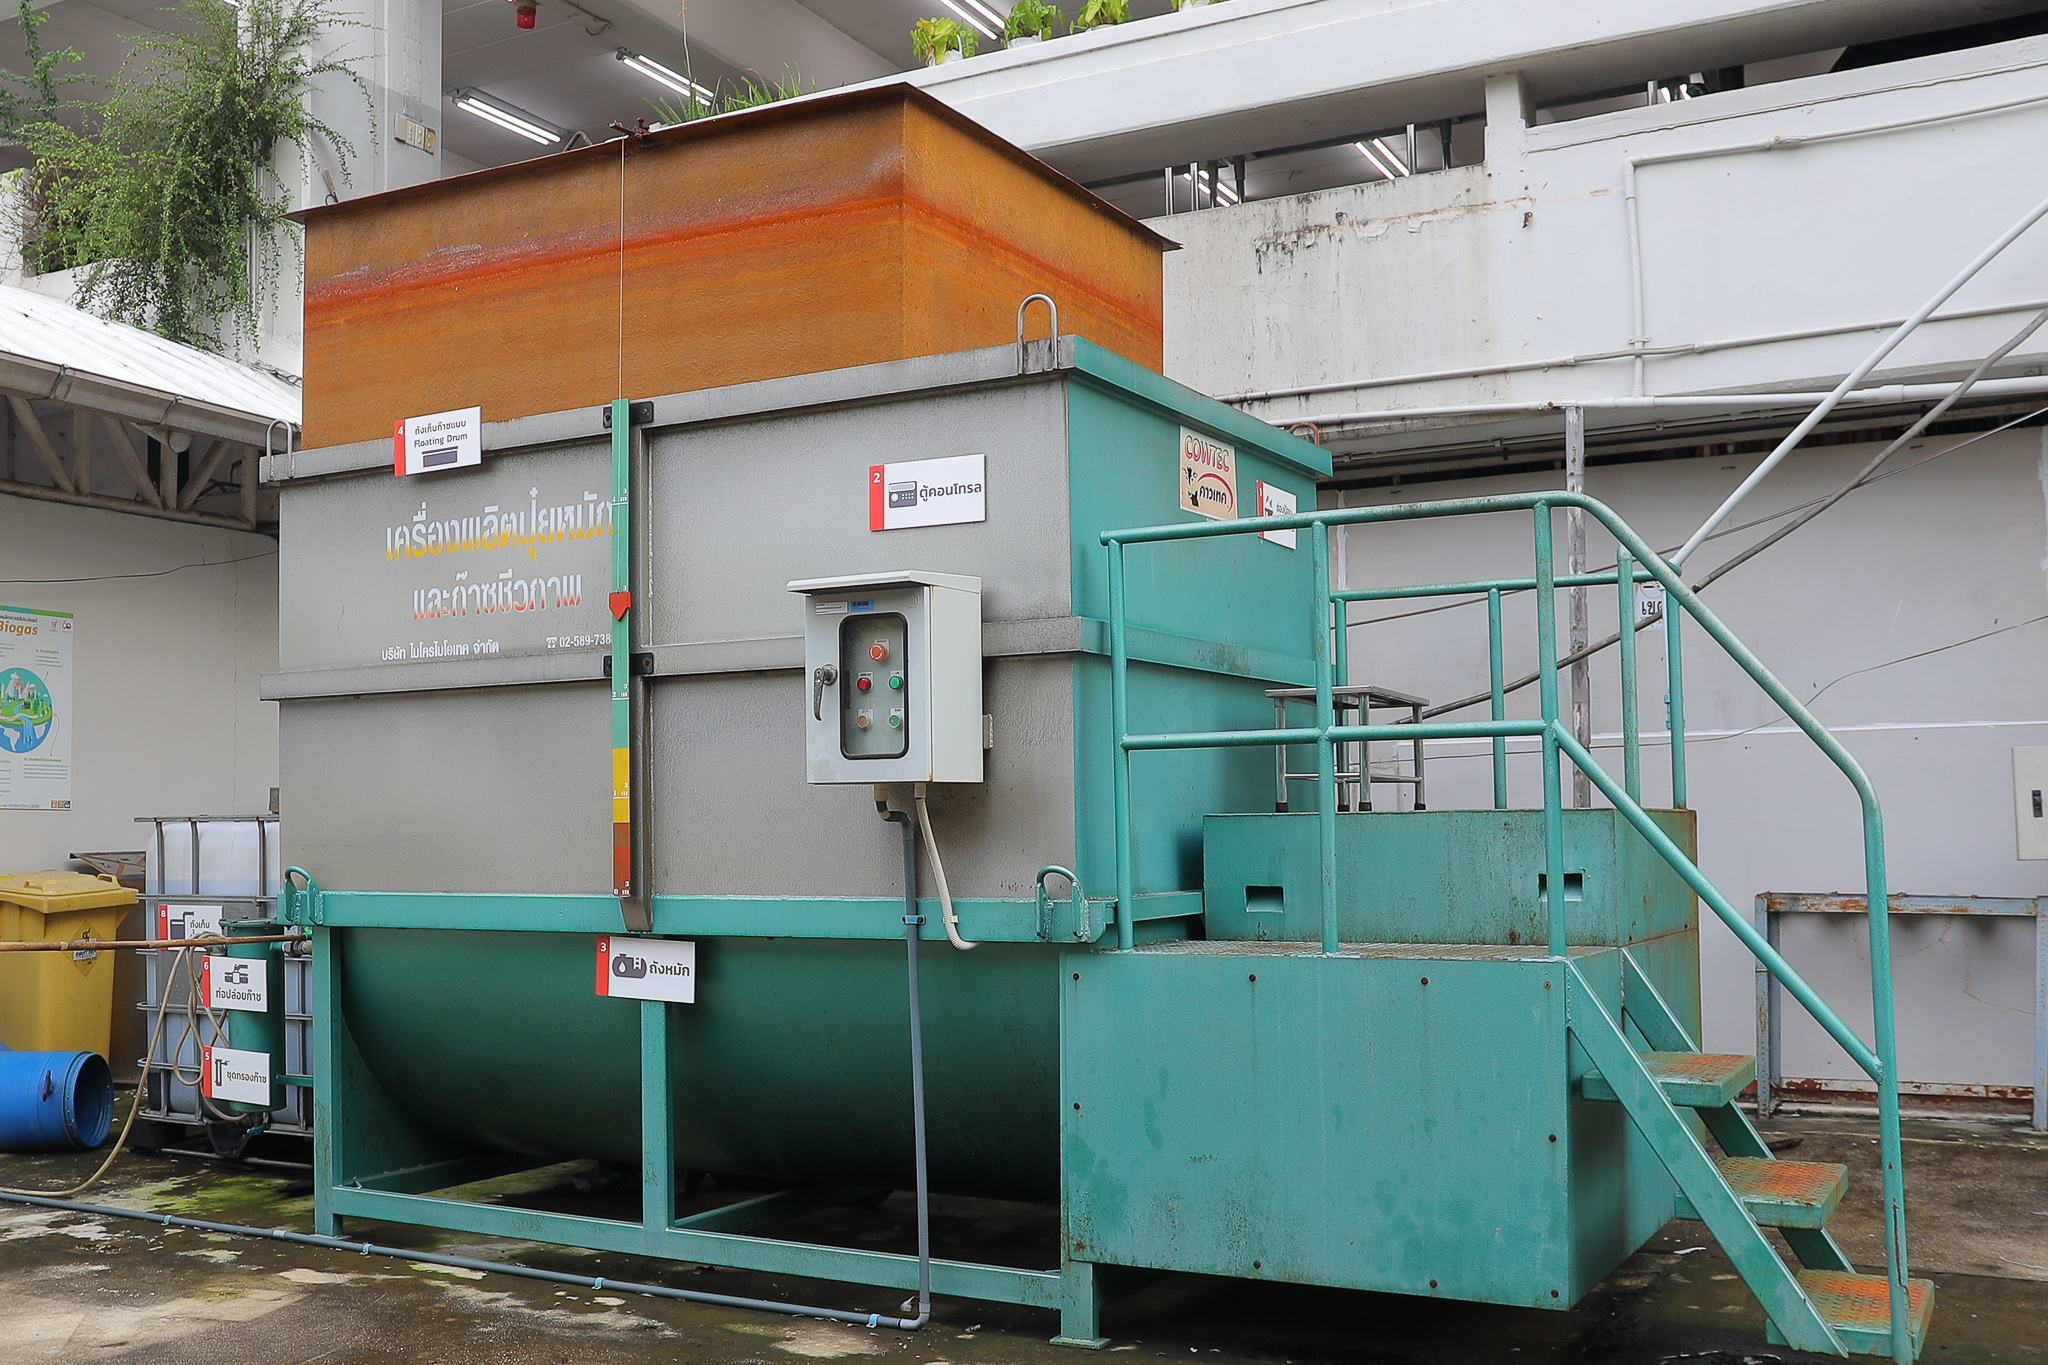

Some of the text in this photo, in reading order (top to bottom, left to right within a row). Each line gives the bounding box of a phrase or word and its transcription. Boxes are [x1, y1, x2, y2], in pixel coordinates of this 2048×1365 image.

[397, 426, 404, 436] 4
[414, 433, 468, 448] Floating Drum
[873, 472, 881, 484] 2
[919, 483, 982, 502] ตู้คอนโทรล
[1200, 485, 1227, 505] คาวเทค
[1259, 487, 1263, 497] 1
[381, 646, 406, 661] บริษัท
[473, 638, 499, 655] จำกัด
[160, 910, 166, 918] 8
[190, 919, 210, 929] ถังเก็บ
[600, 942, 607, 952] 3
[203, 961, 209, 971] 6
[649, 960, 690, 976] ถังหมัก
